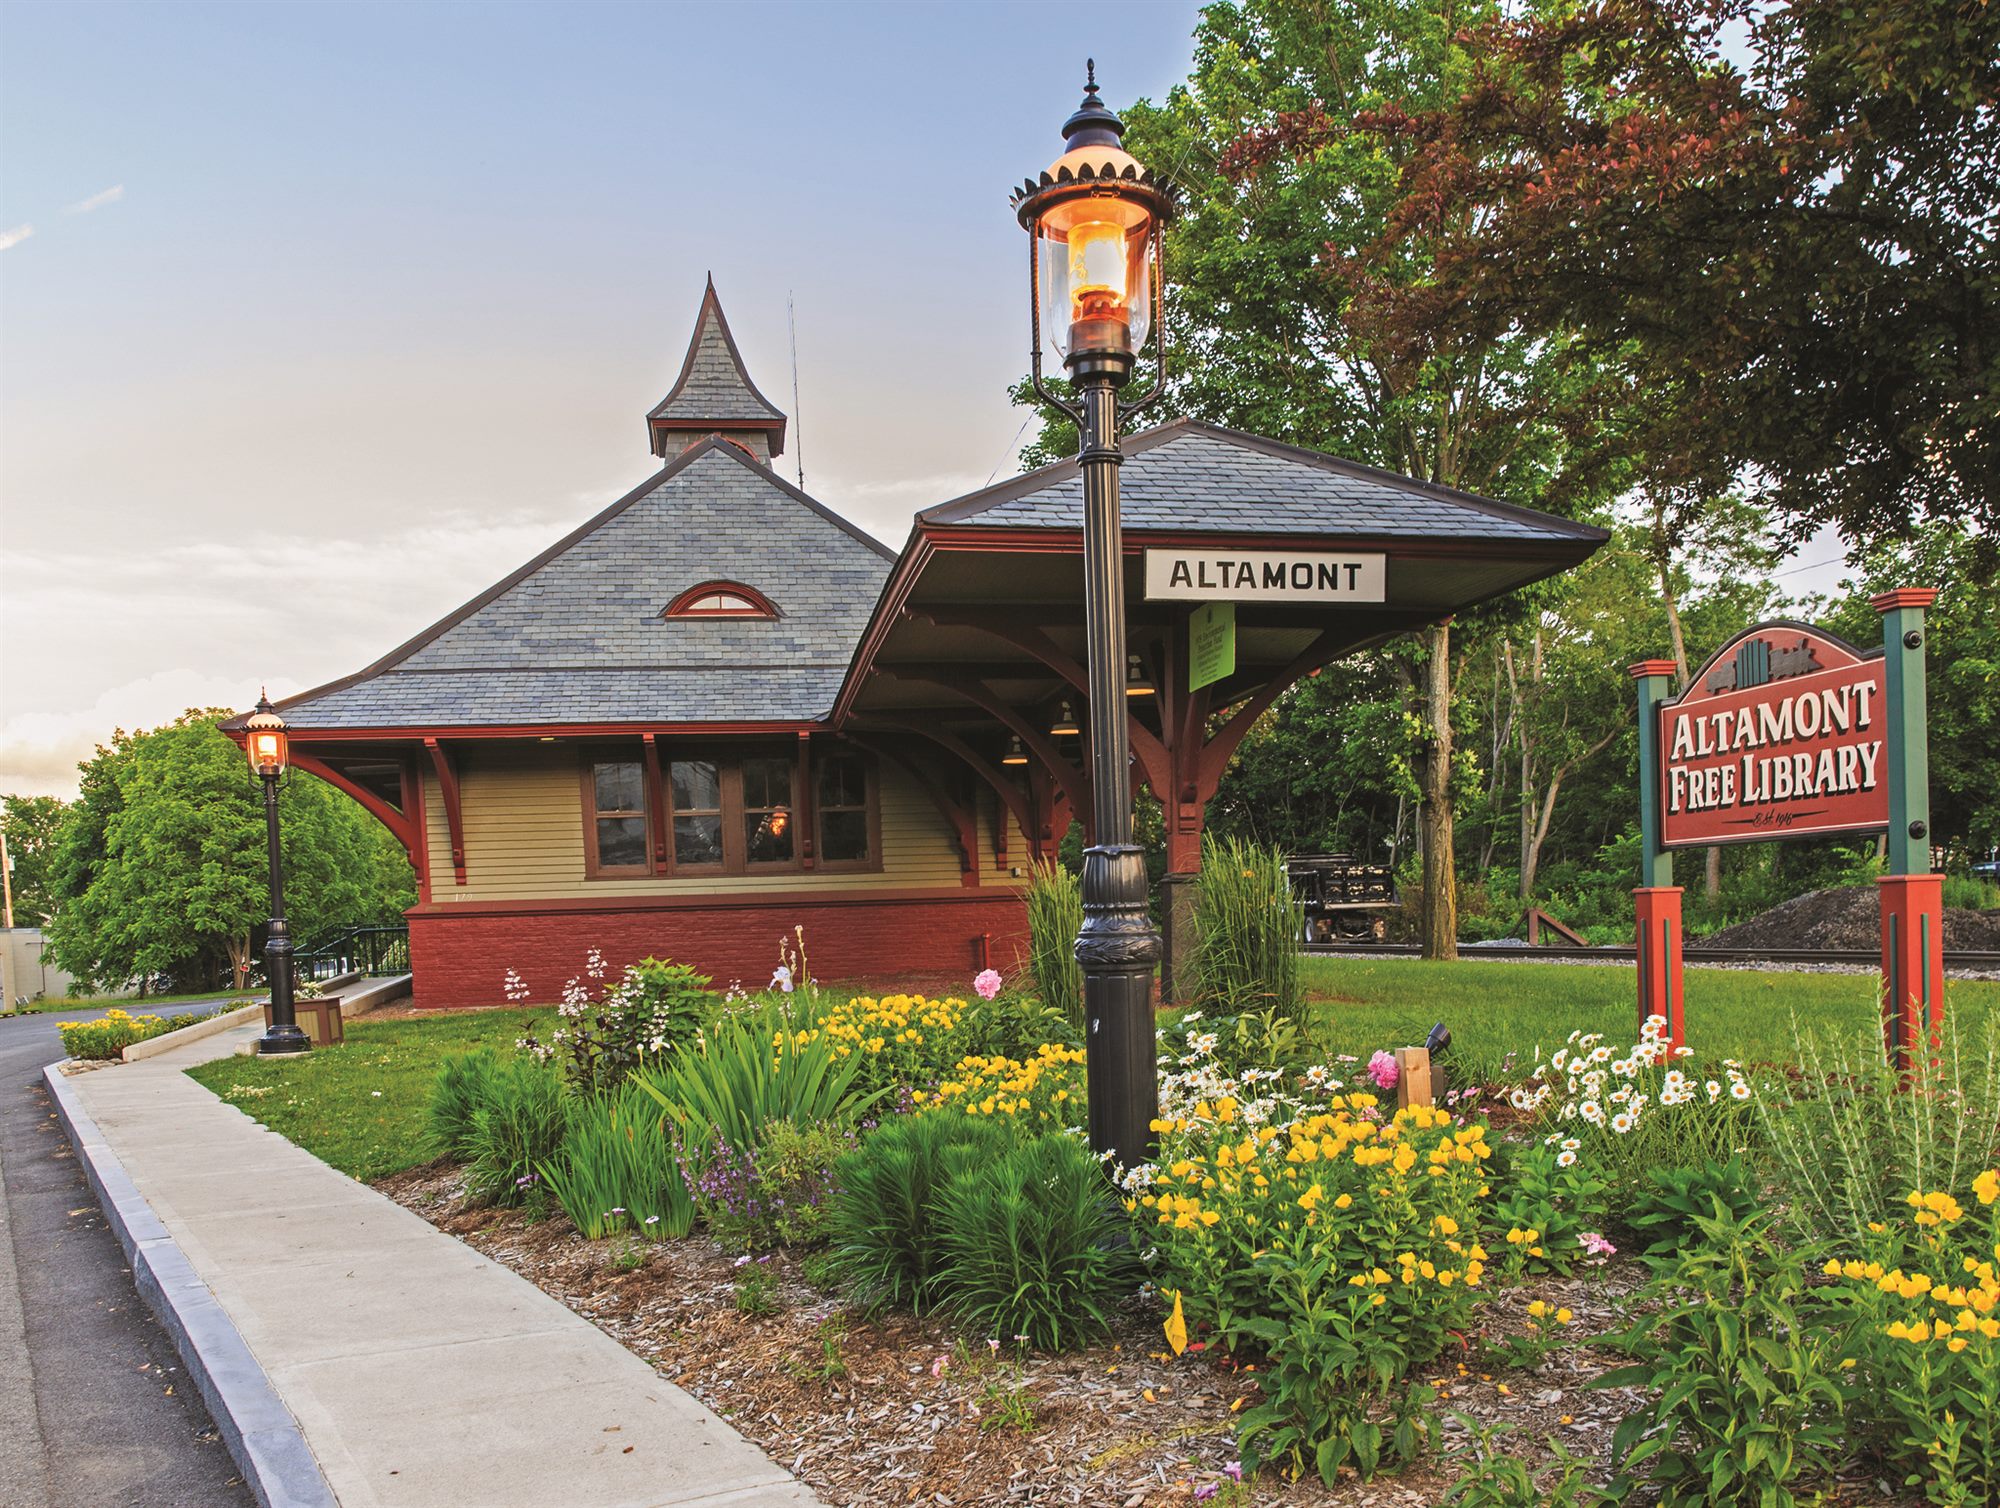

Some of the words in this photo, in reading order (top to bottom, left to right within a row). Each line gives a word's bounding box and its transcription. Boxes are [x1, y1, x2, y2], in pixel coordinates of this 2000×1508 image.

[1169, 560, 1362, 590] ALTAMONT
[1670, 680, 1877, 760] ALTAMONT
[1669, 763, 1737, 812] FREE
[1742, 740, 1882, 803] LIBRARY
